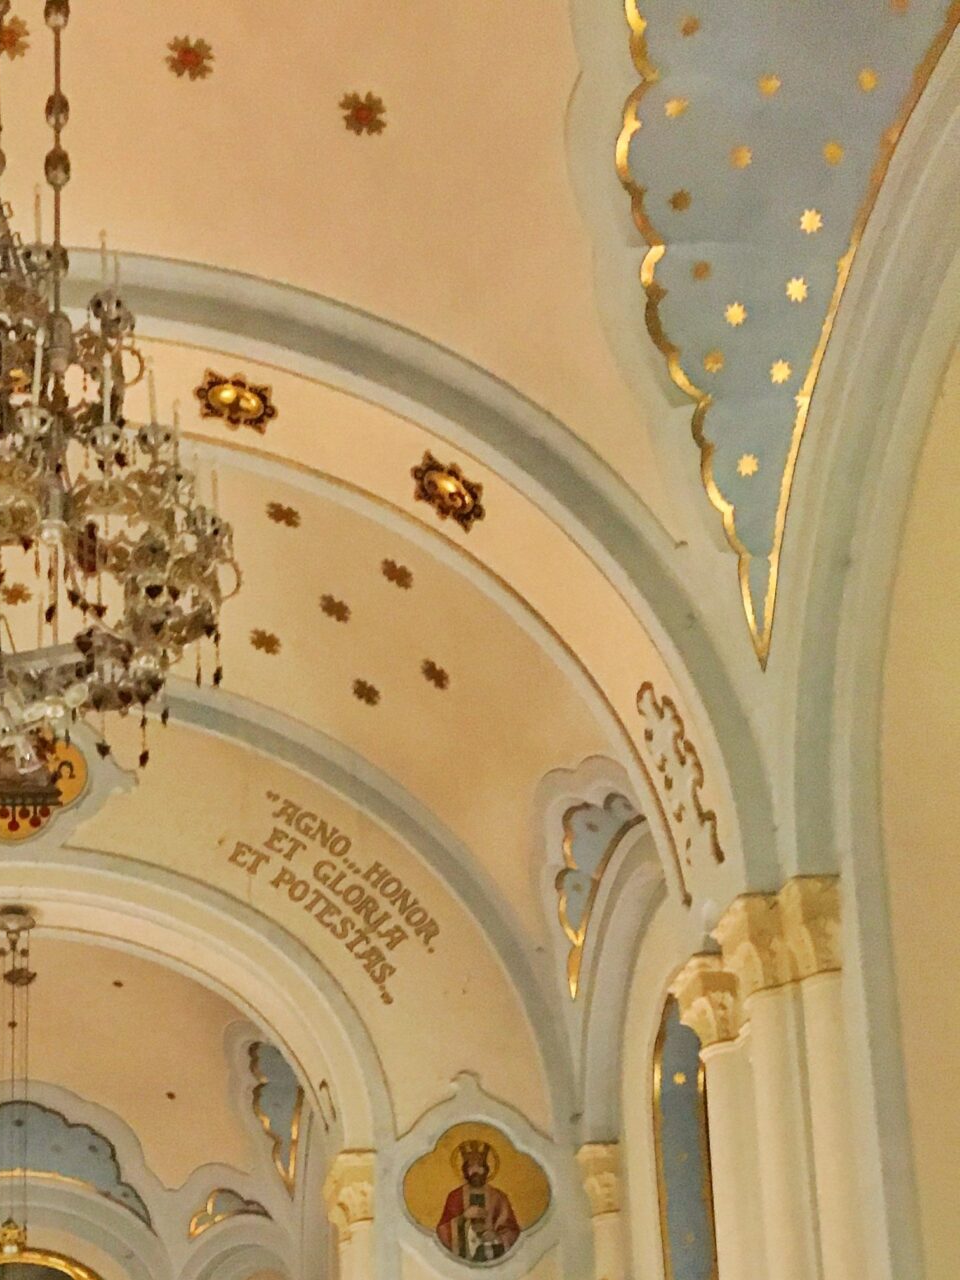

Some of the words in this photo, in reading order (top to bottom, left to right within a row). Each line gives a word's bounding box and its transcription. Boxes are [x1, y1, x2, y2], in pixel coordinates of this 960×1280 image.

[227, 841, 270, 875] ET
[263, 827, 307, 861] ET
[312, 859, 409, 951] GLORIA
